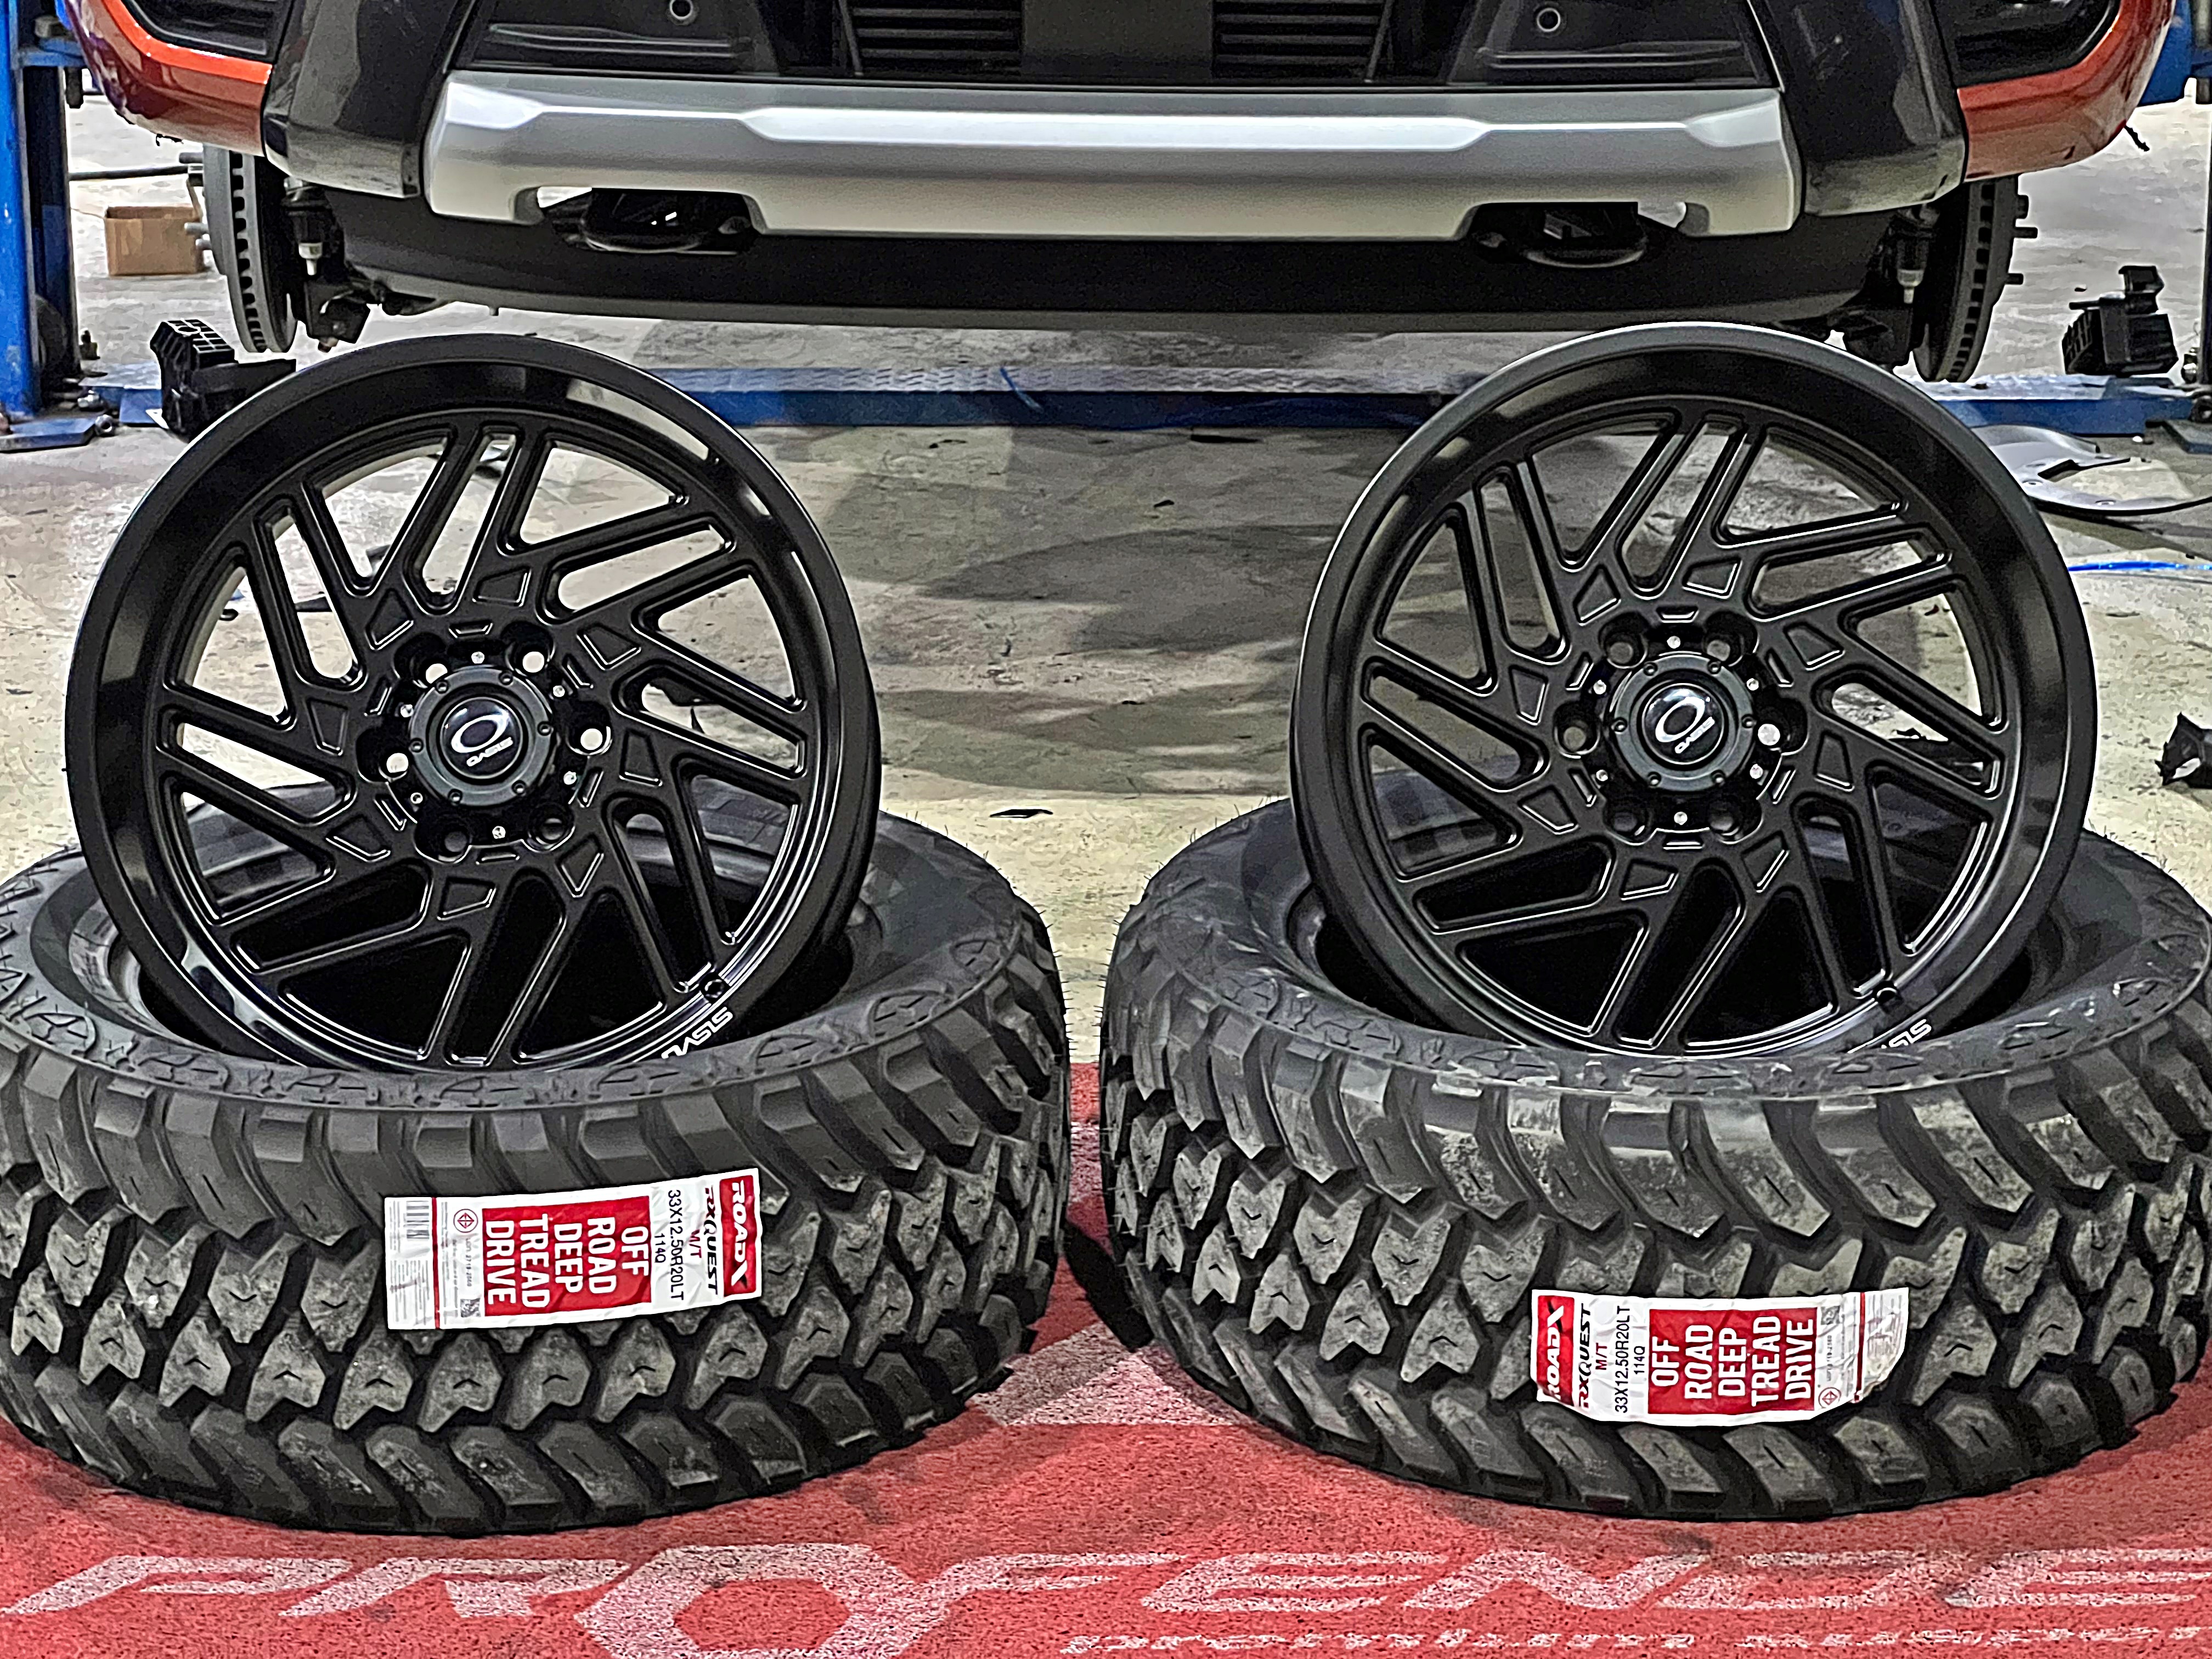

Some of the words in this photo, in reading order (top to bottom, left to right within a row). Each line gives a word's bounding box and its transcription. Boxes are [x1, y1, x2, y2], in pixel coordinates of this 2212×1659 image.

[486, 1220, 516, 1306] DRIVE
[520, 1213, 550, 1308] TREAD
[554, 1222, 584, 1294] DEEP
[587, 1217, 617, 1294] ROAD
[621, 1226, 648, 1278] OFF
[654, 1232, 666, 1263] 114Q
[668, 1189, 684, 1301] 33X12.50R20LT
[689, 1228, 702, 1258] M/T
[703, 1185, 718, 1295] RXQUEST
[730, 1180, 749, 1289] ROADX
[1547, 1301, 1565, 1400] ROADX
[1578, 1303, 1592, 1408] RXQUEST
[1595, 1342, 1607, 1370] M/T
[1615, 1305, 1630, 1413] 33X12.50R20LT
[1633, 1345, 1645, 1375] 114Q
[1651, 1335, 1680, 1387] OFF
[1685, 1324, 1714, 1399] ROAD
[1718, 1327, 1748, 1396] DEEP
[1751, 1315, 1781, 1407] TREAD
[1785, 1319, 1813, 1400] DRIVE
